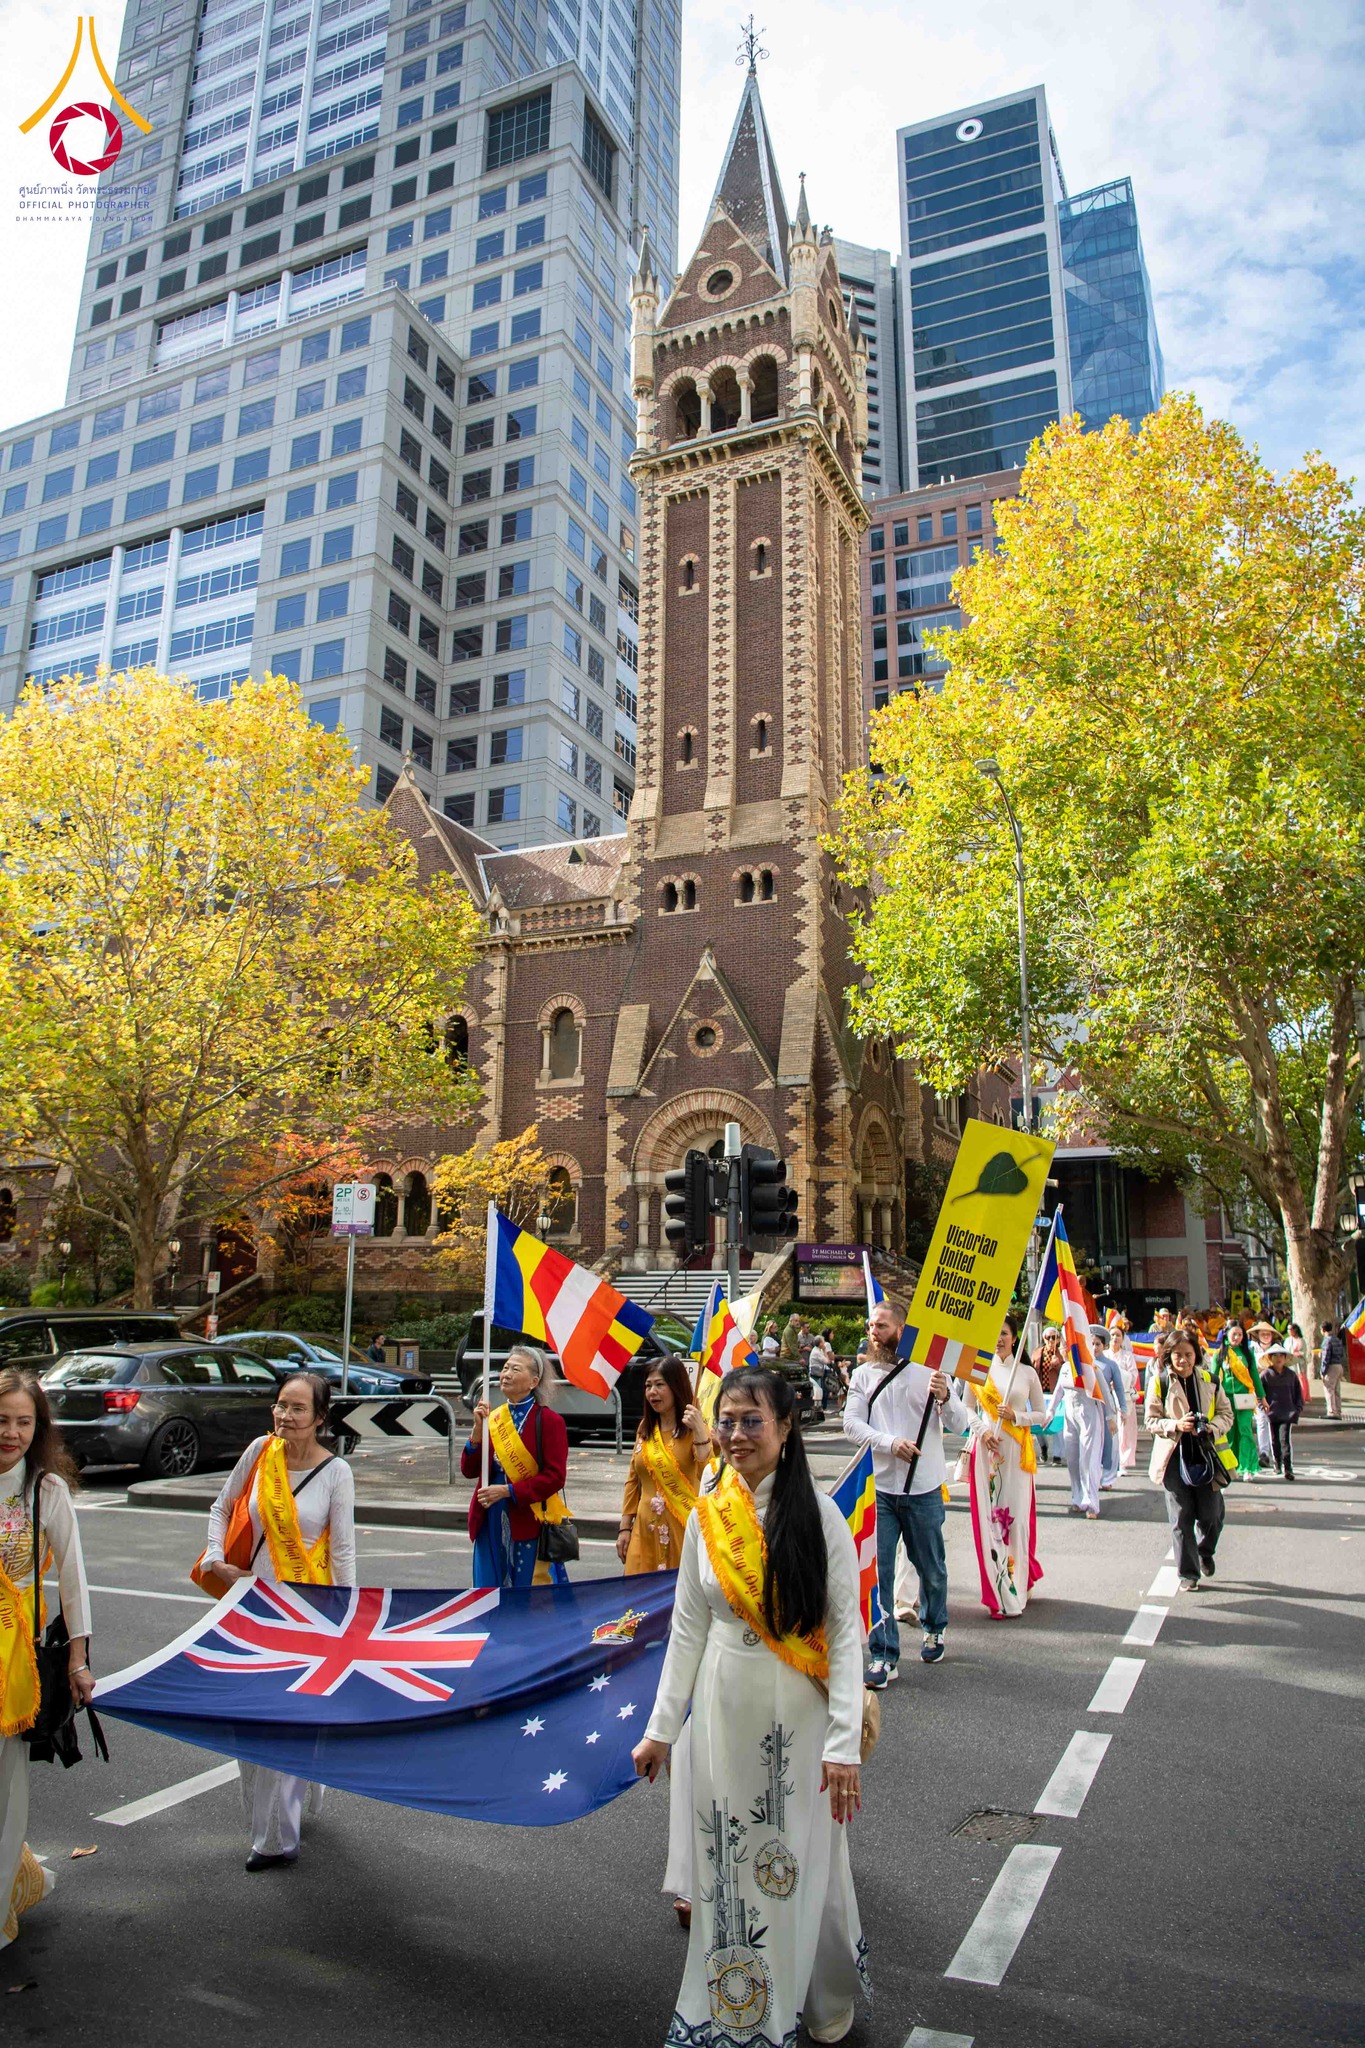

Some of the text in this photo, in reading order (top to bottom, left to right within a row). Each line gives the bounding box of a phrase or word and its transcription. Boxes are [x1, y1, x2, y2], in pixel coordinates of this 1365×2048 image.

[336, 1187, 352, 1198] 2P
[946, 1224, 998, 1258] Victorian
[939, 1245, 976, 1274] United
[932, 1266, 1000, 1308] Nations Day
[925, 1289, 975, 1321] of Vesak
